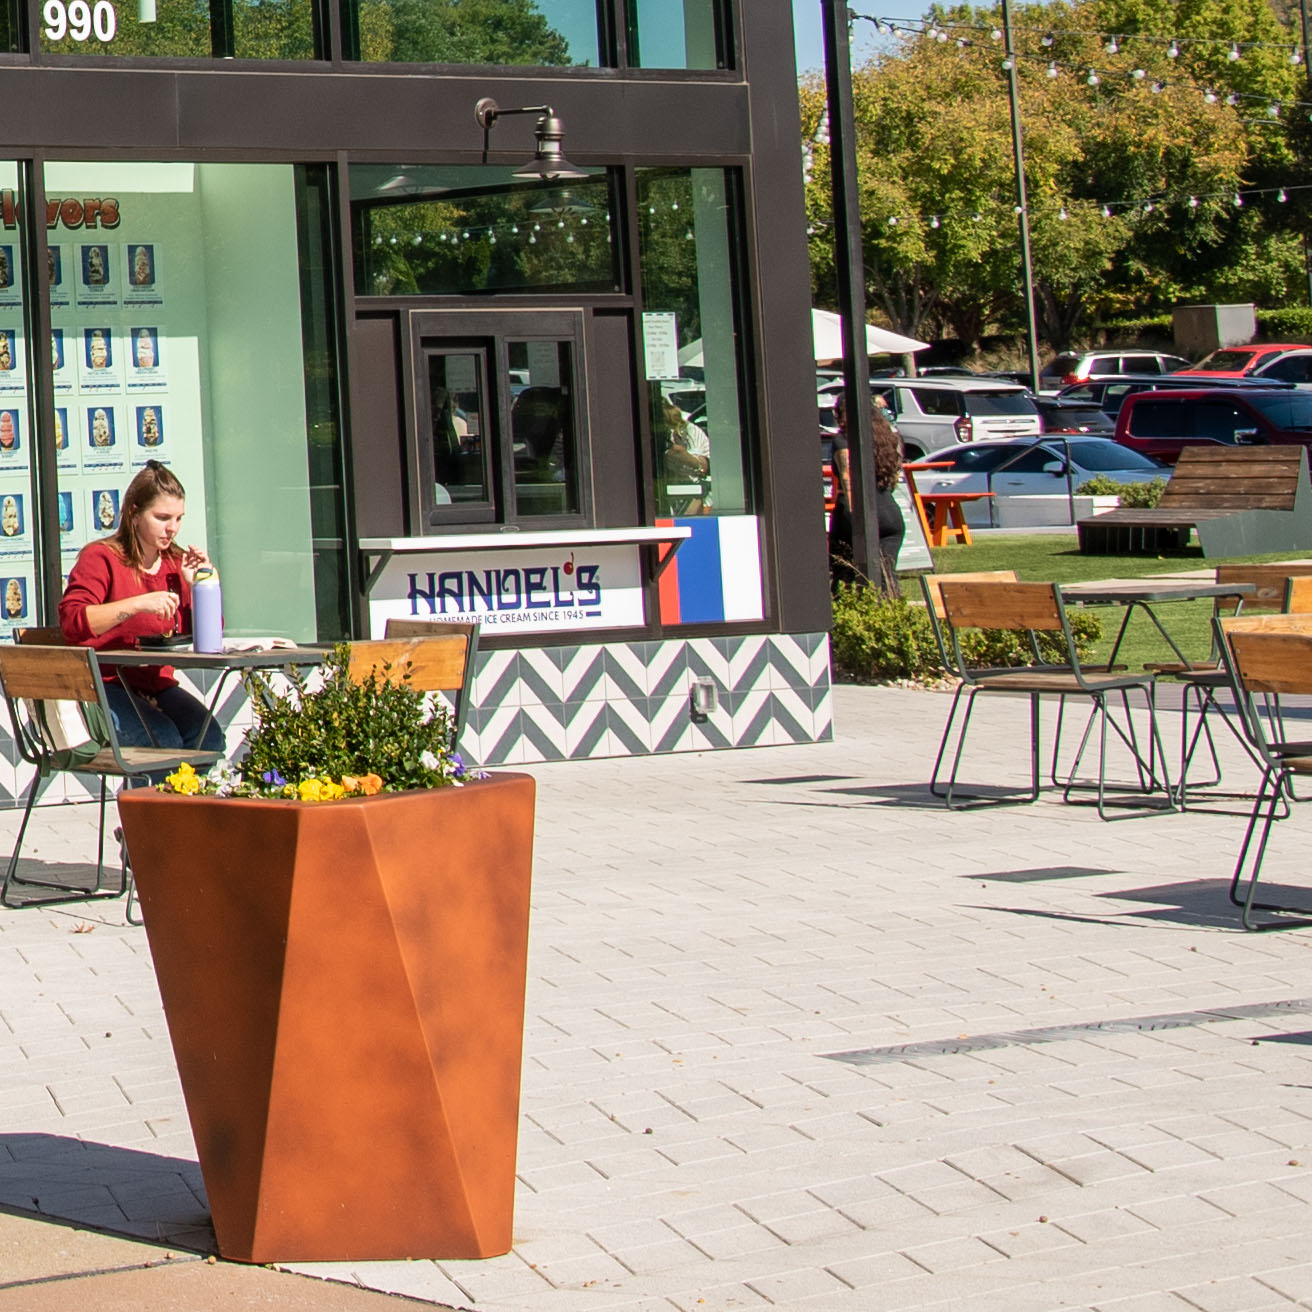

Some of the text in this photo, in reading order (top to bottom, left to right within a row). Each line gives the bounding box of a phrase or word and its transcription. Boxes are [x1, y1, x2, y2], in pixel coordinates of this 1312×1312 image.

[407, 558, 602, 615] HANDEL'S
[484, 614, 497, 625] ICE
[500, 612, 531, 624] CREAM
[533, 610, 559, 622] SINCE
[563, 610, 584, 620] 1945
